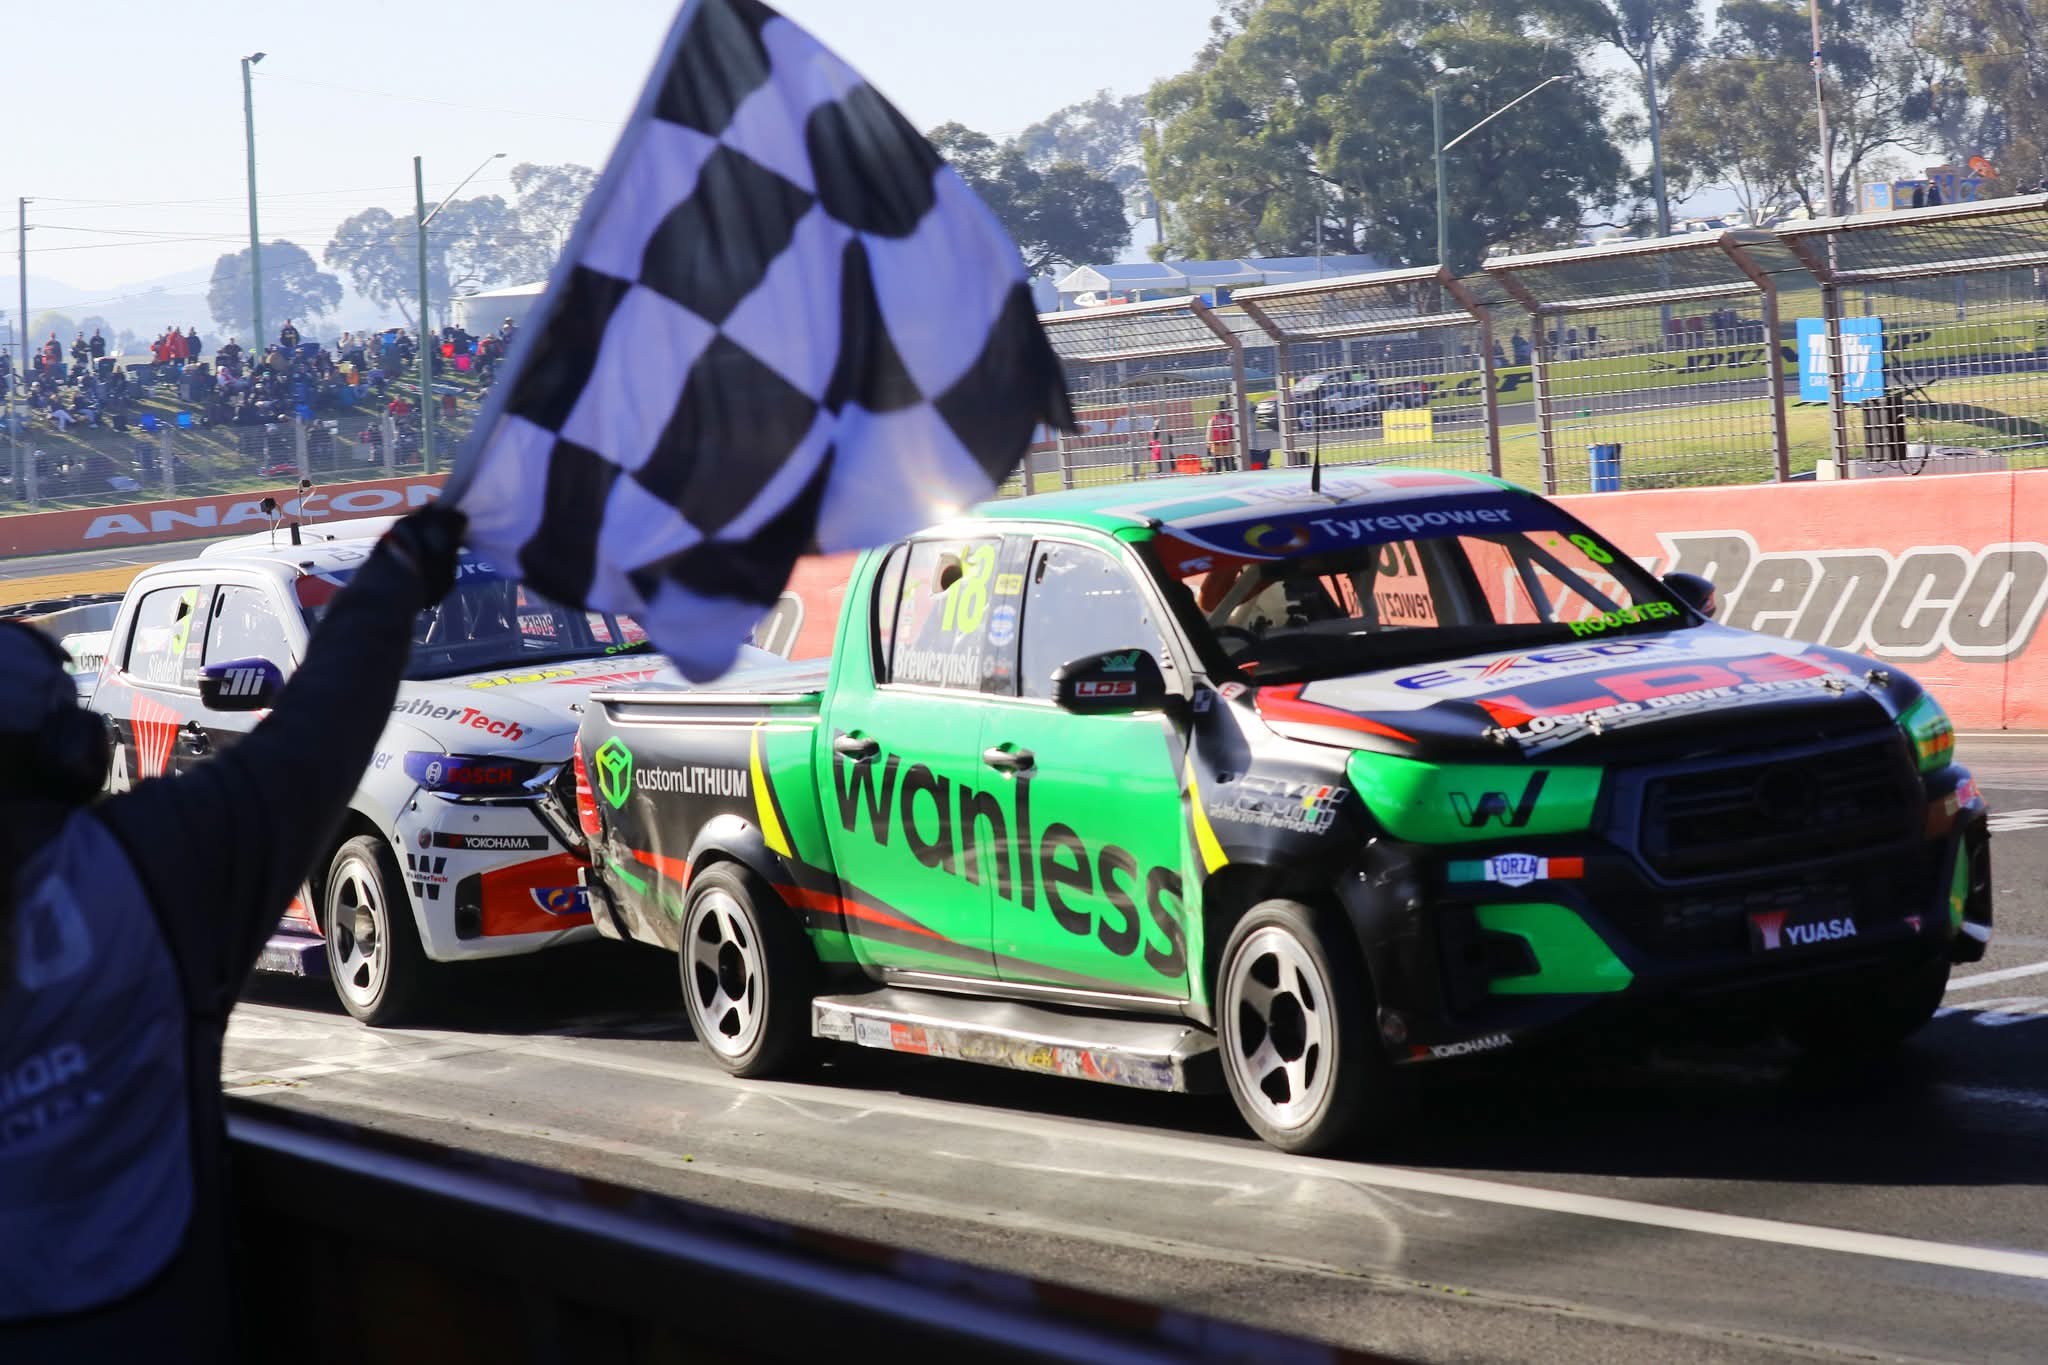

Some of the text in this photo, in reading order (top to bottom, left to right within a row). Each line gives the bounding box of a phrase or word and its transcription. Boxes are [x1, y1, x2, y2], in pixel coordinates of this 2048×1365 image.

[84, 484, 443, 539] ANACON
[1311, 506, 1513, 540] Tyrepower
[942, 544, 996, 634] 18
[1568, 602, 1679, 636] ROOSTER
[893, 643, 981, 688] Brewczynski
[1077, 682, 1134, 695] LDS
[393, 698, 525, 742] atherTech
[1508, 675, 1842, 739] LOCKED DRIVE SYSTE
[447, 766, 513, 785] BOSCH
[635, 765, 748, 798] customLITHIUM
[465, 836, 530, 849] YOKOHAMA
[832, 751, 1188, 978] wanless
[1491, 856, 1538, 875] FORZA
[1785, 917, 1858, 946] YUASA
[1430, 1033, 1513, 1057] YOKOHAMA
